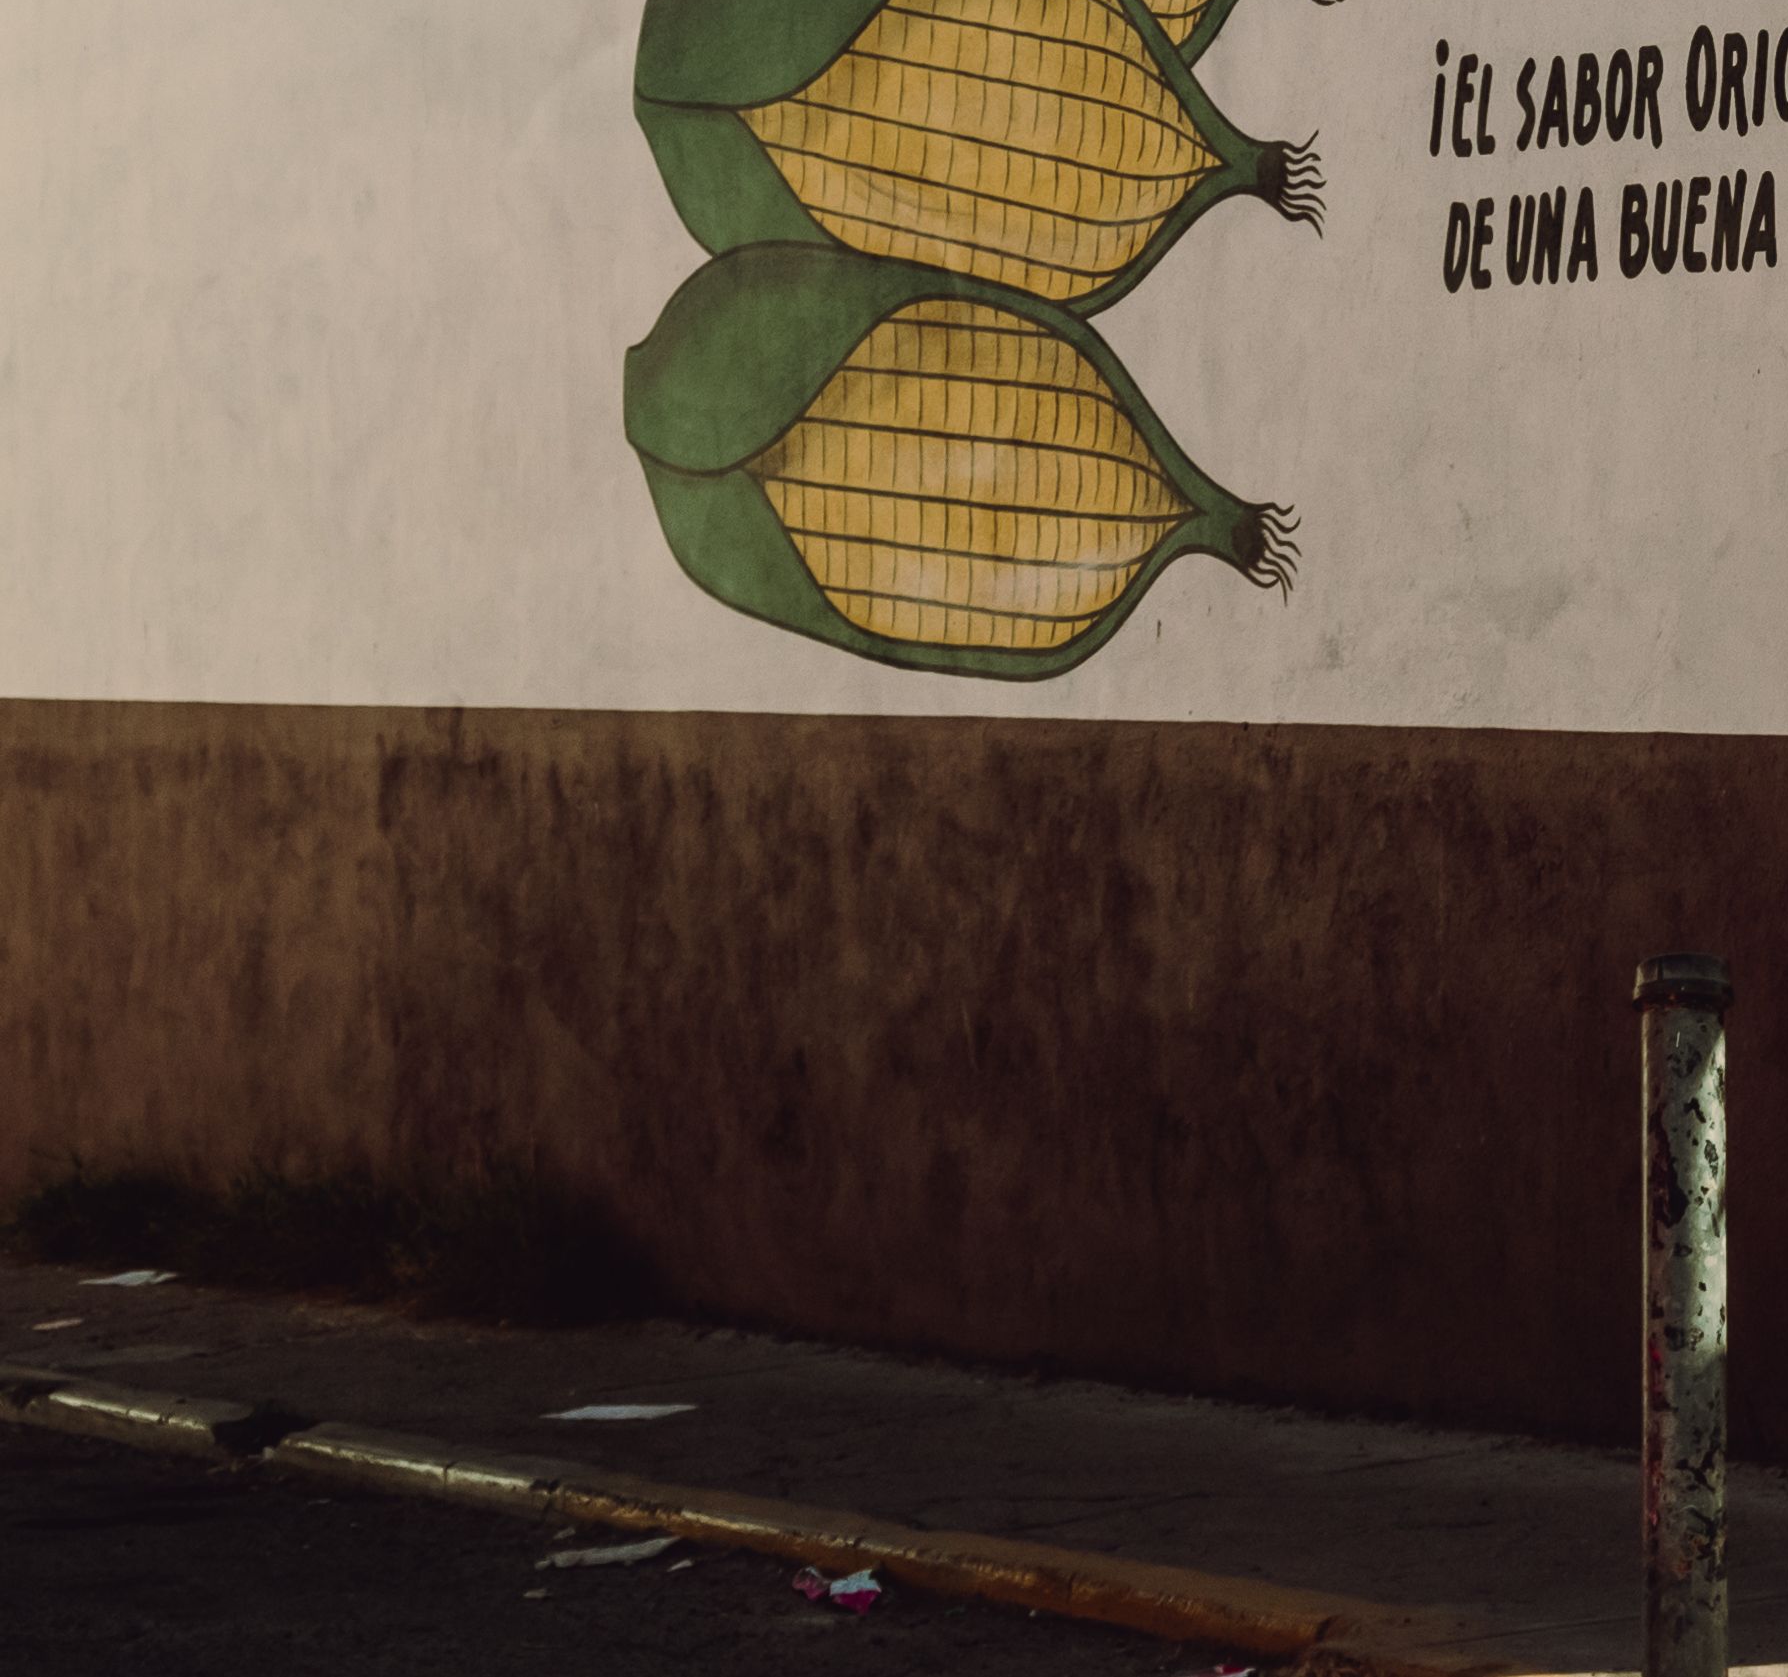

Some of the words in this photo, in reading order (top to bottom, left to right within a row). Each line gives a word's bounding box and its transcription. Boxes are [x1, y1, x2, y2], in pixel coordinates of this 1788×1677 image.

[1517, 44, 1663, 150] SABOR
[1443, 197, 1493, 294] DE
[1505, 186, 1599, 288] UNA
[1619, 170, 1778, 279] BUENA
